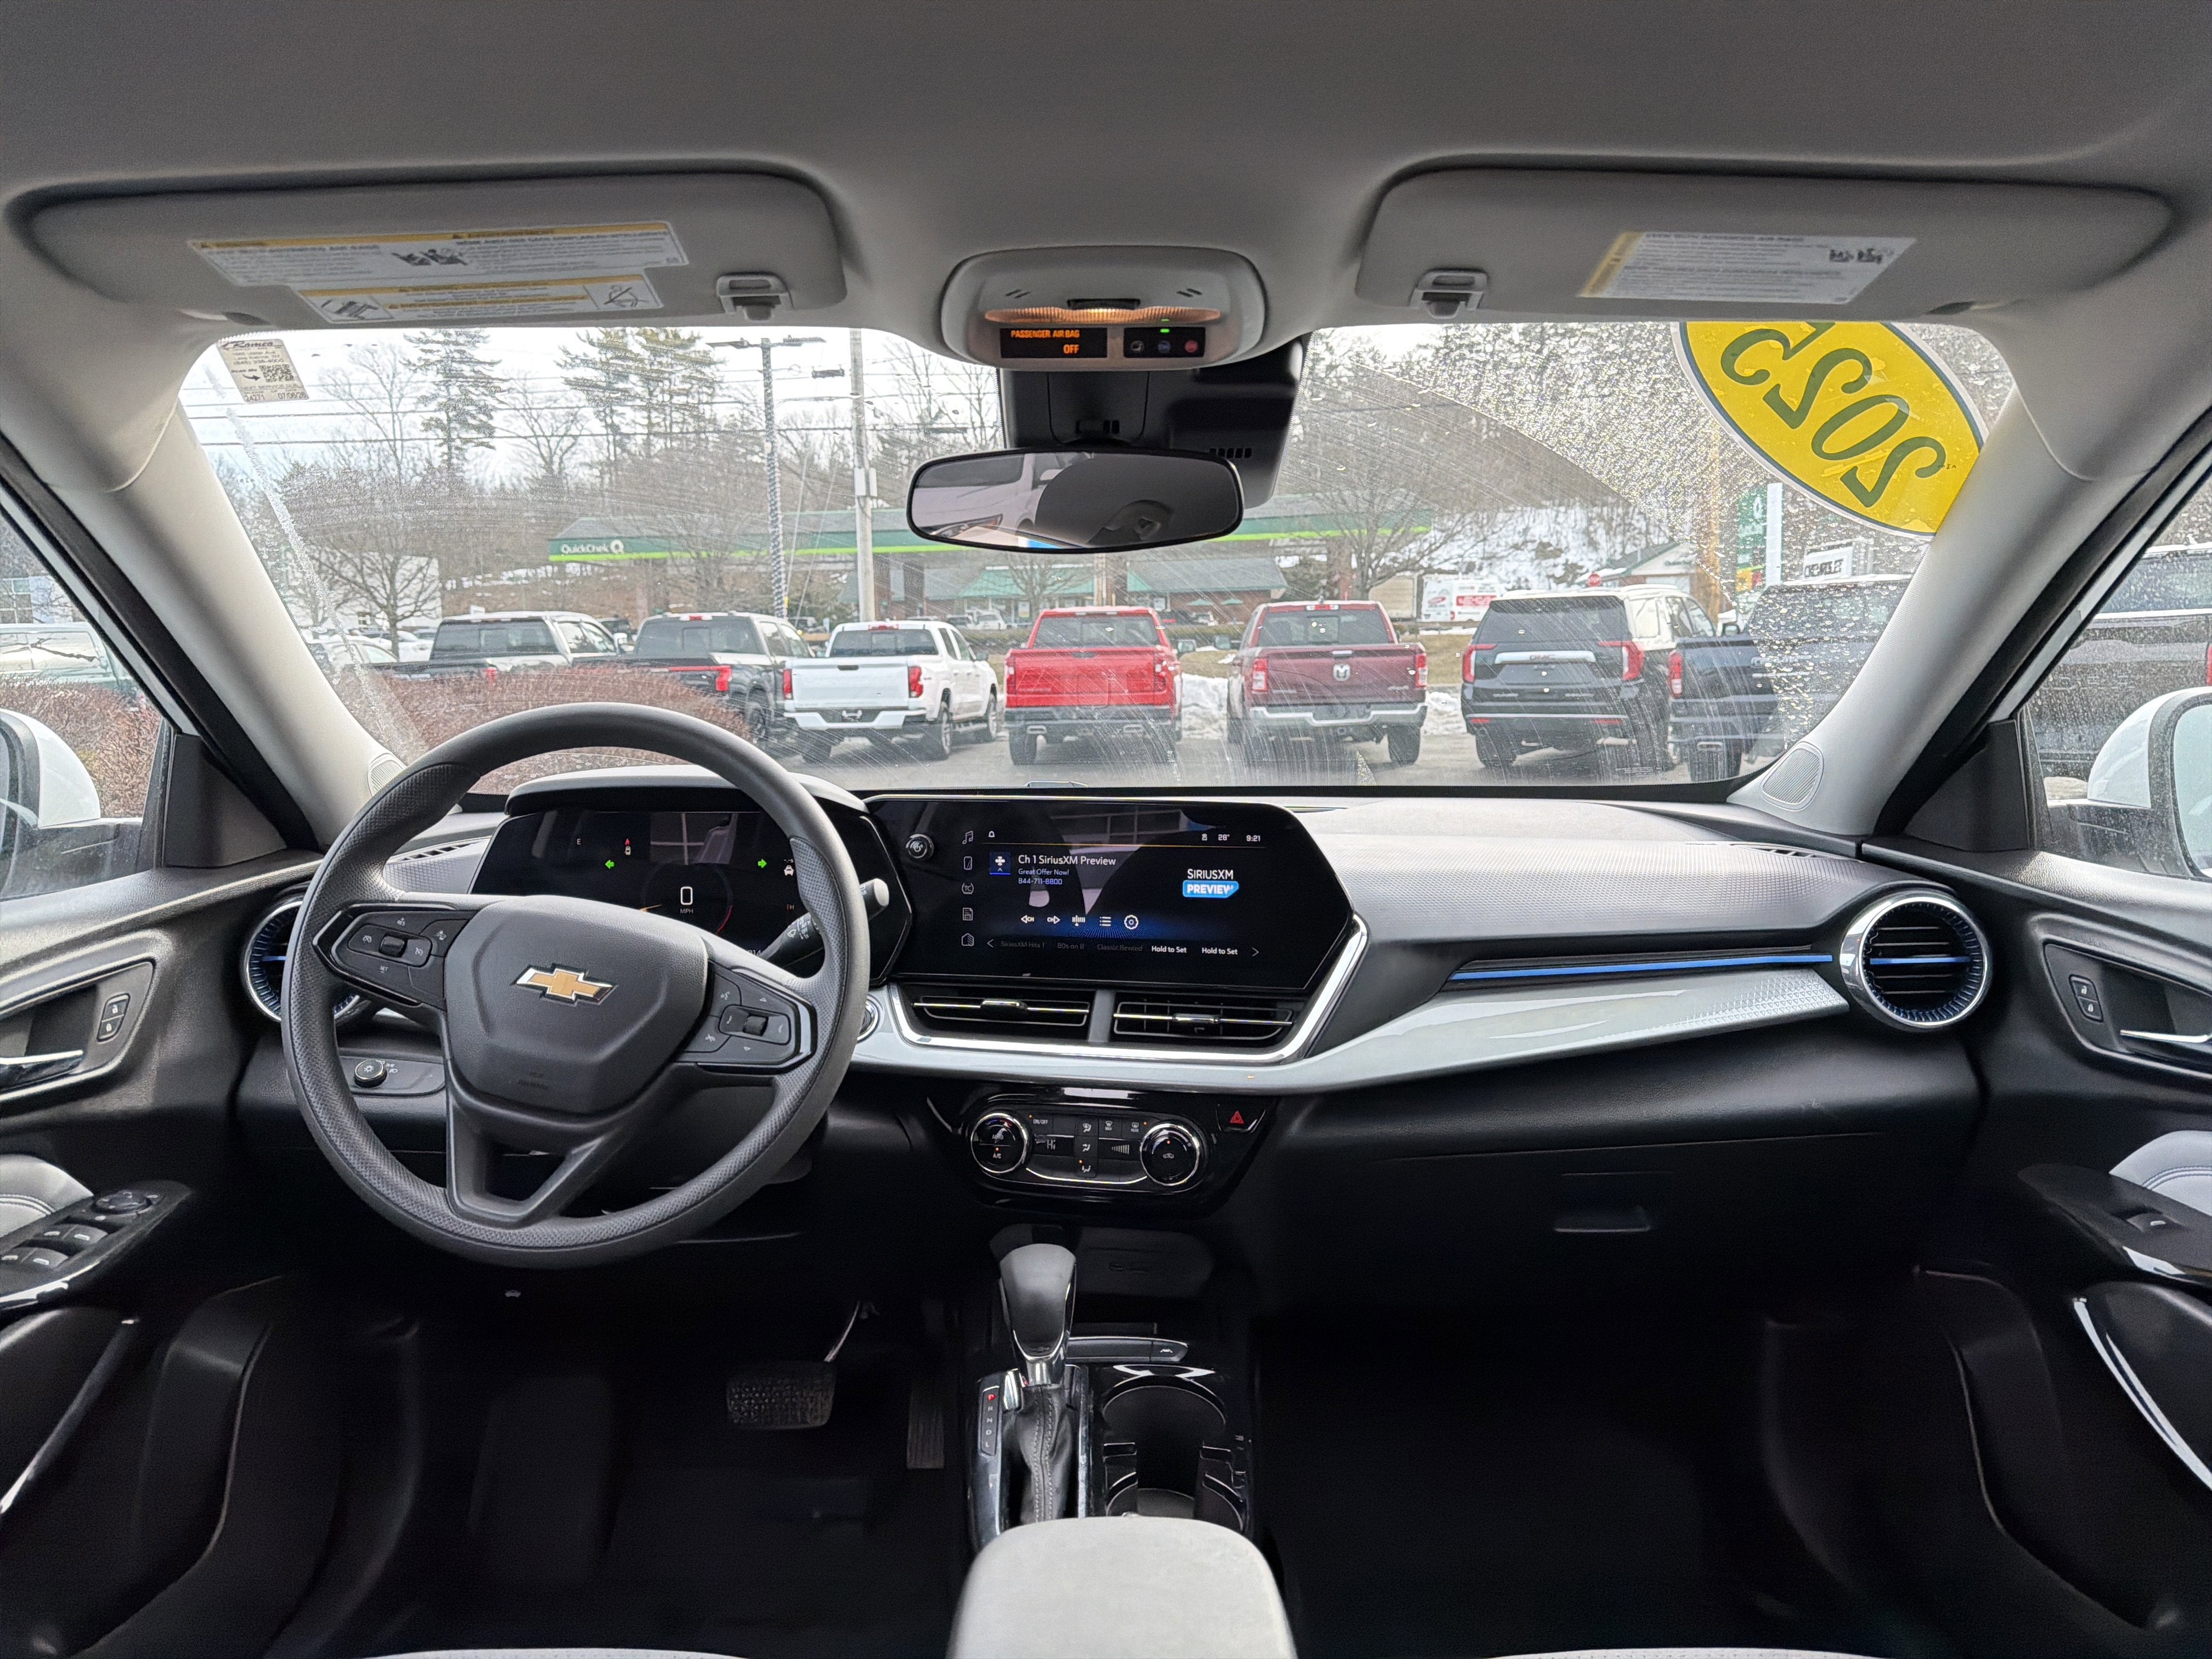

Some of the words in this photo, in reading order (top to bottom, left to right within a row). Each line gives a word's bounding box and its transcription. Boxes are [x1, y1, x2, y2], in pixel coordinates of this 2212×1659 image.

[1011, 330, 1051, 338] PASSENGER
[1063, 344, 1080, 354] OFF
[561, 543, 610, 554] QuickChek
[1018, 855, 1031, 865] Ch
[1032, 855, 1037, 865] 1
[1039, 855, 1078, 865] SiriusXM
[1080, 855, 1116, 866] Preview
[1187, 868, 1234, 880] SIRIUSXM
[1187, 884, 1234, 895] PREVIEW
[680, 886, 693, 906] 0
